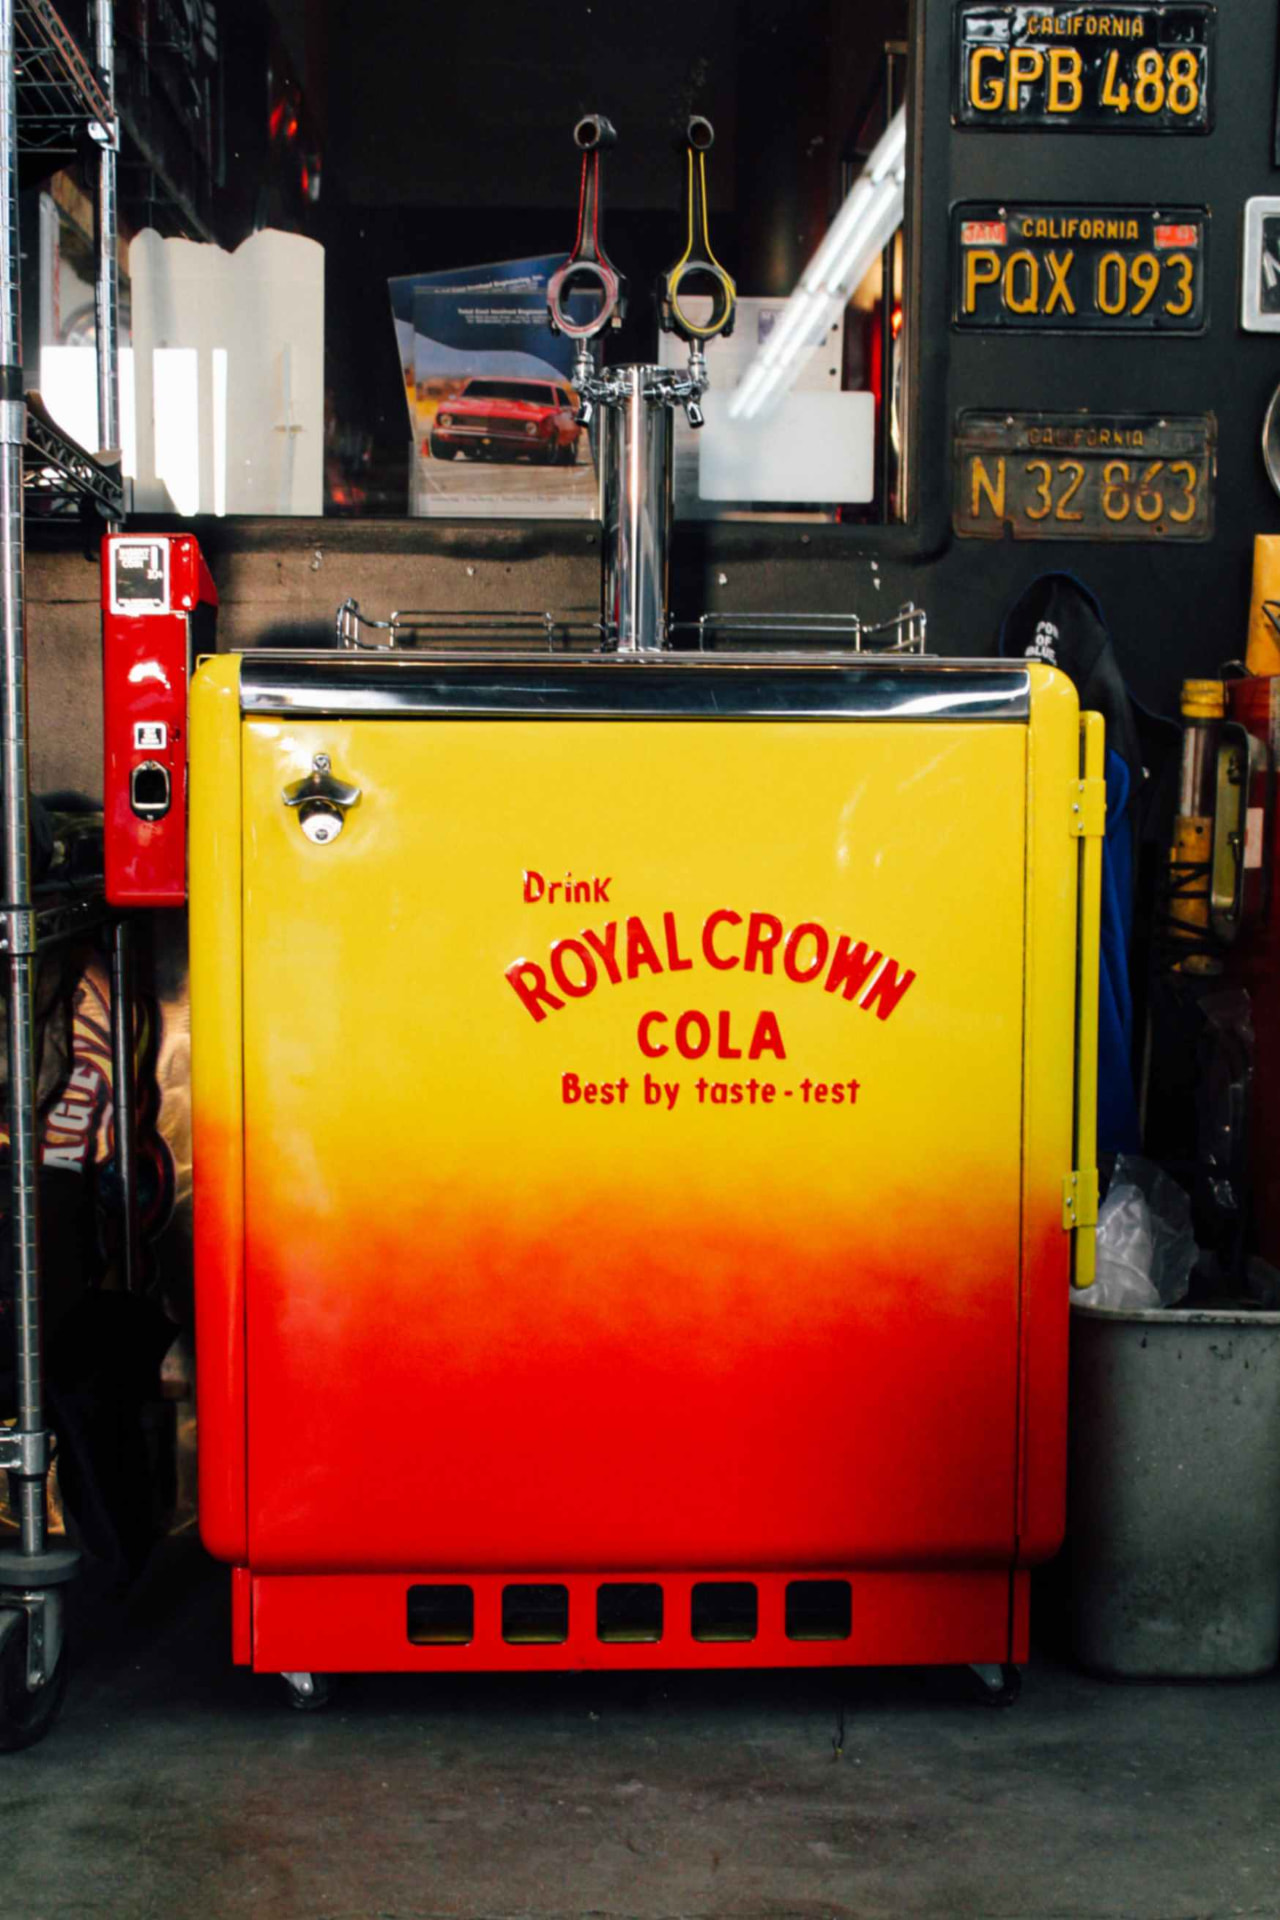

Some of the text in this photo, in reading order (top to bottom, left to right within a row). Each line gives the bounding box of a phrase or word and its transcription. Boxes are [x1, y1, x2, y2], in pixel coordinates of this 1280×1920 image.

[1027, 16, 1144, 37] CALIFORNIA
[970, 47, 1199, 115] GPB 488
[1022, 218, 1139, 240] CALIFORNIA
[964, 250, 1194, 315] PQX 093
[971, 456, 1006, 518] N
[1025, 459, 1085, 521] 32
[1035, 633, 1052, 648] OF
[522, 870, 612, 904] Drink
[504, 908, 917, 1023] ROYAL CROWN
[637, 1010, 787, 1060] COLA
[561, 1072, 629, 1105] Best
[643, 1073, 680, 1111] by
